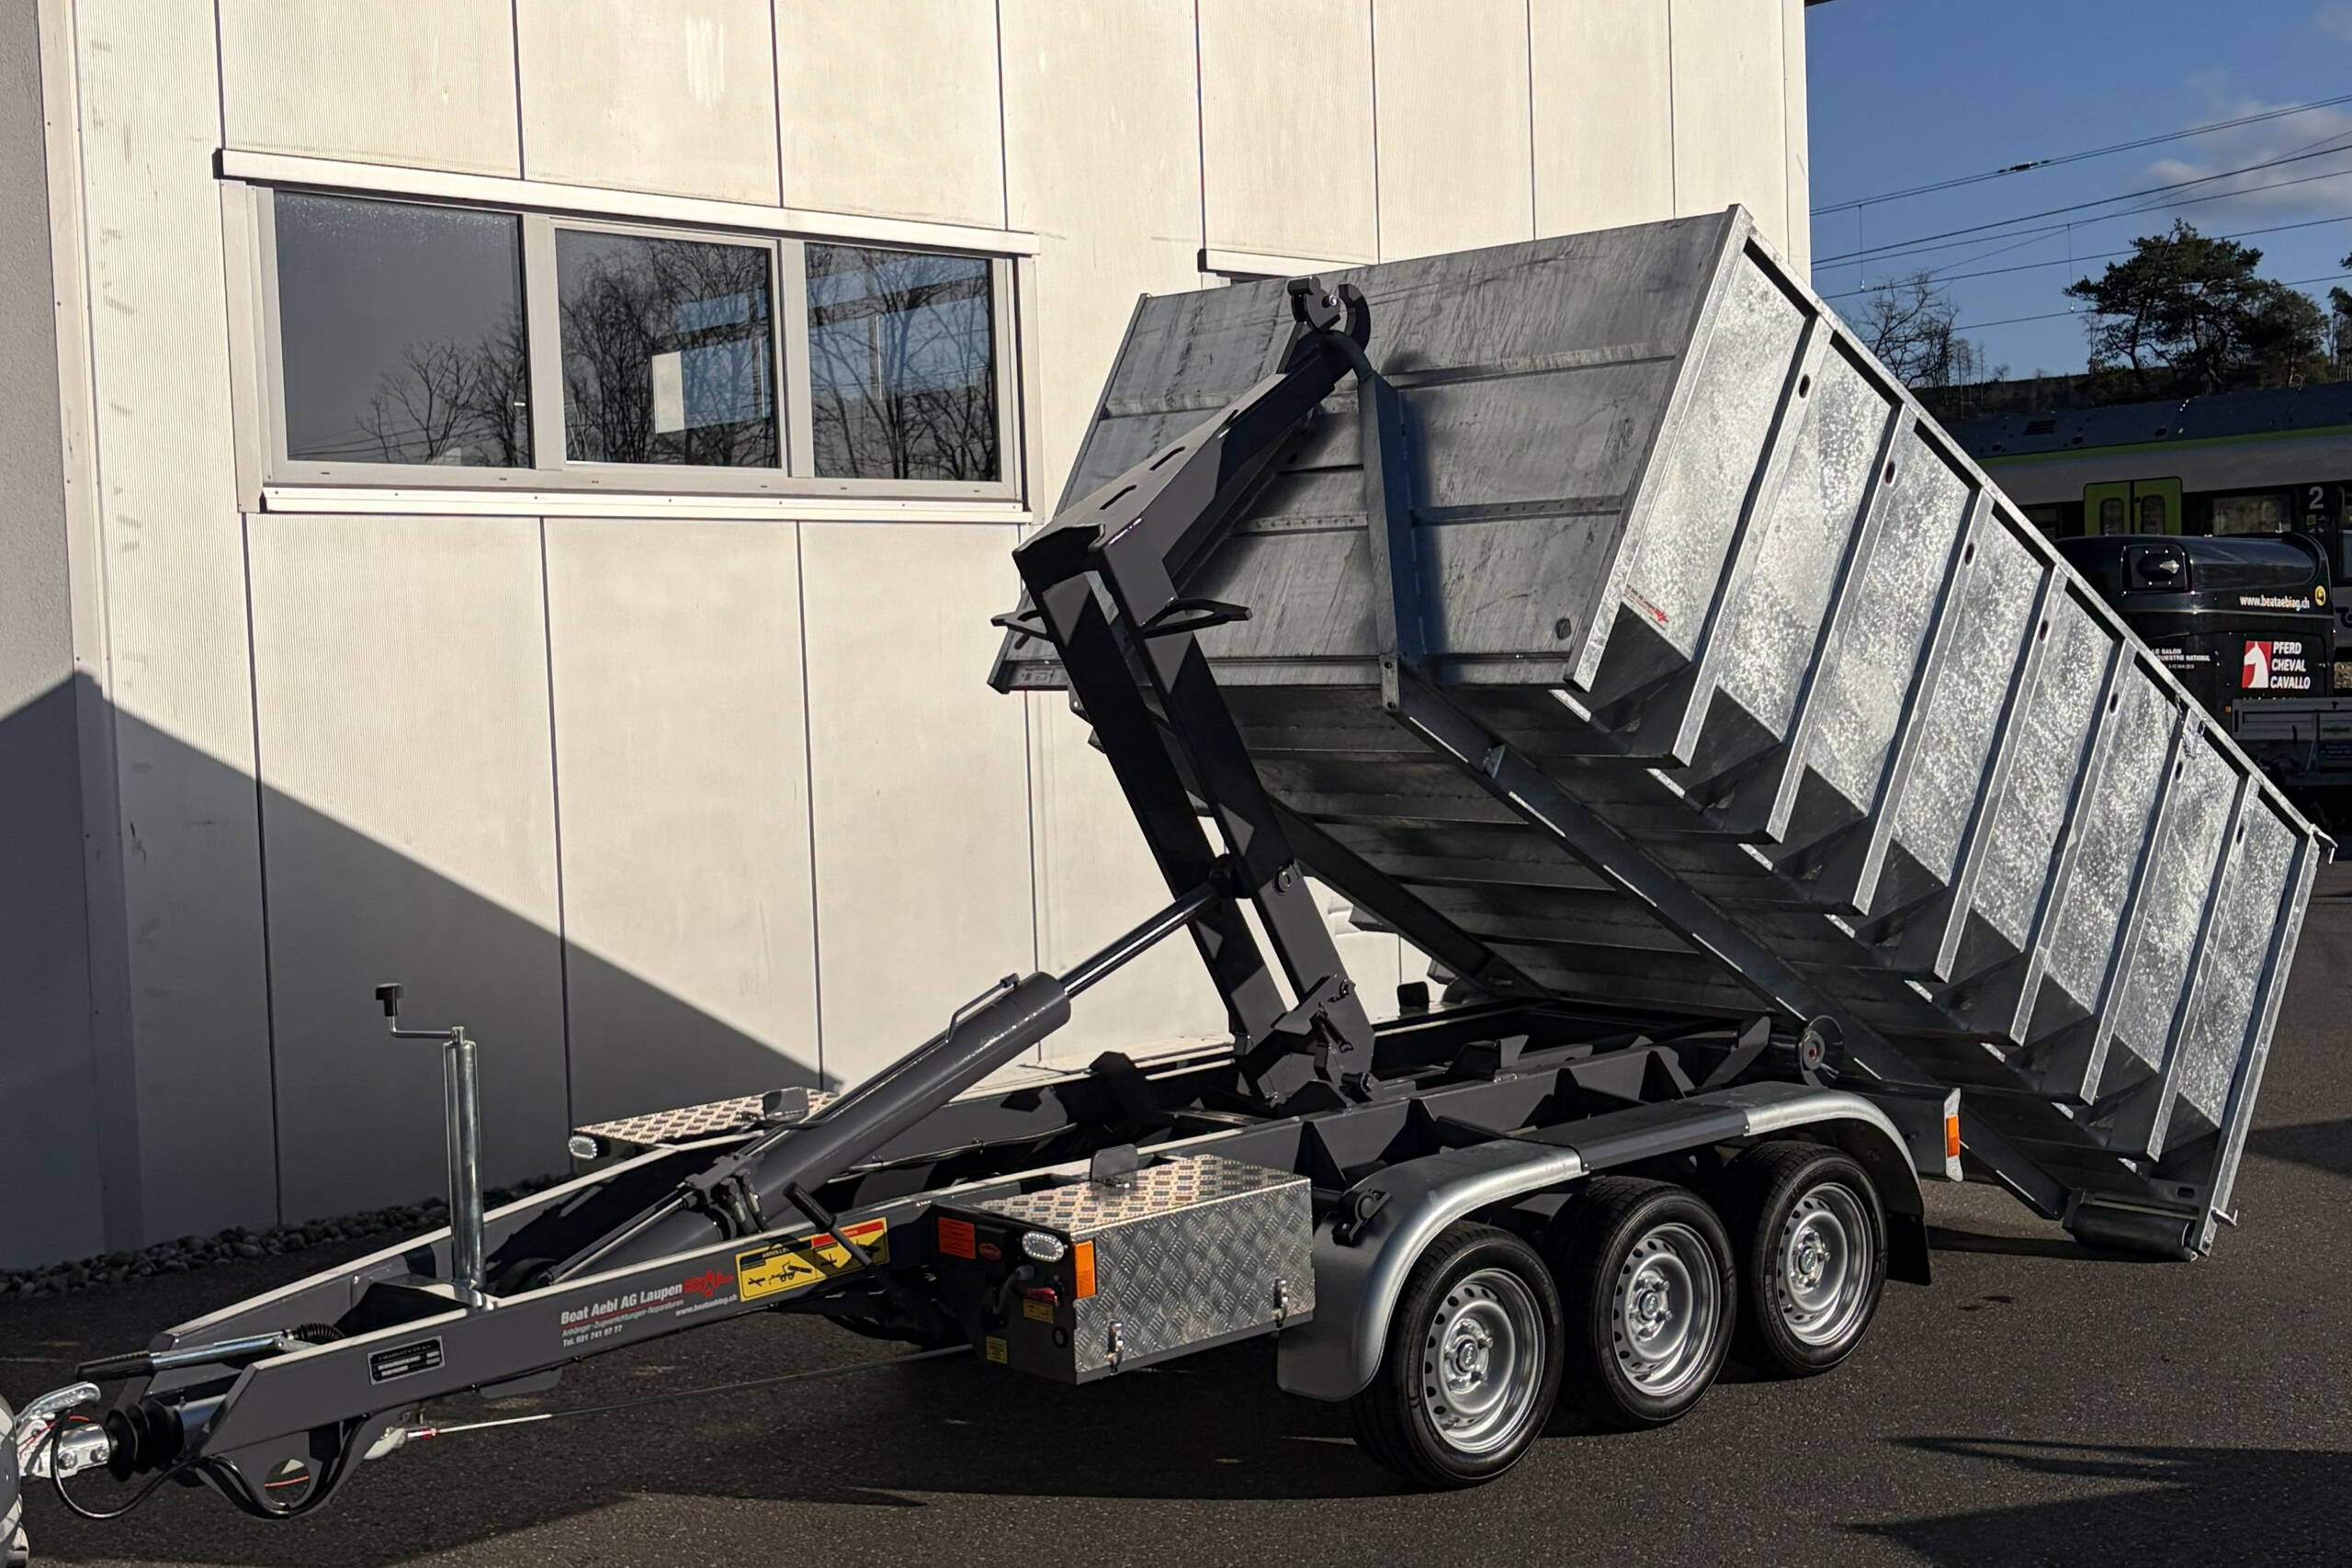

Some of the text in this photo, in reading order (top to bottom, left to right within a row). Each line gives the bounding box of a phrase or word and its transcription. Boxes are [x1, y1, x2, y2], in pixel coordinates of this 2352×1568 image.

[2309, 486, 2324, 510] 2
[2239, 594, 2311, 611] www.beataebiag.ch
[2273, 641, 2302, 655] PFERD
[2271, 659, 2307, 671] CHEVAL
[2270, 676, 2312, 690] CAVALLO
[561, 1282, 683, 1325] Beat Aebi AG Laupen
